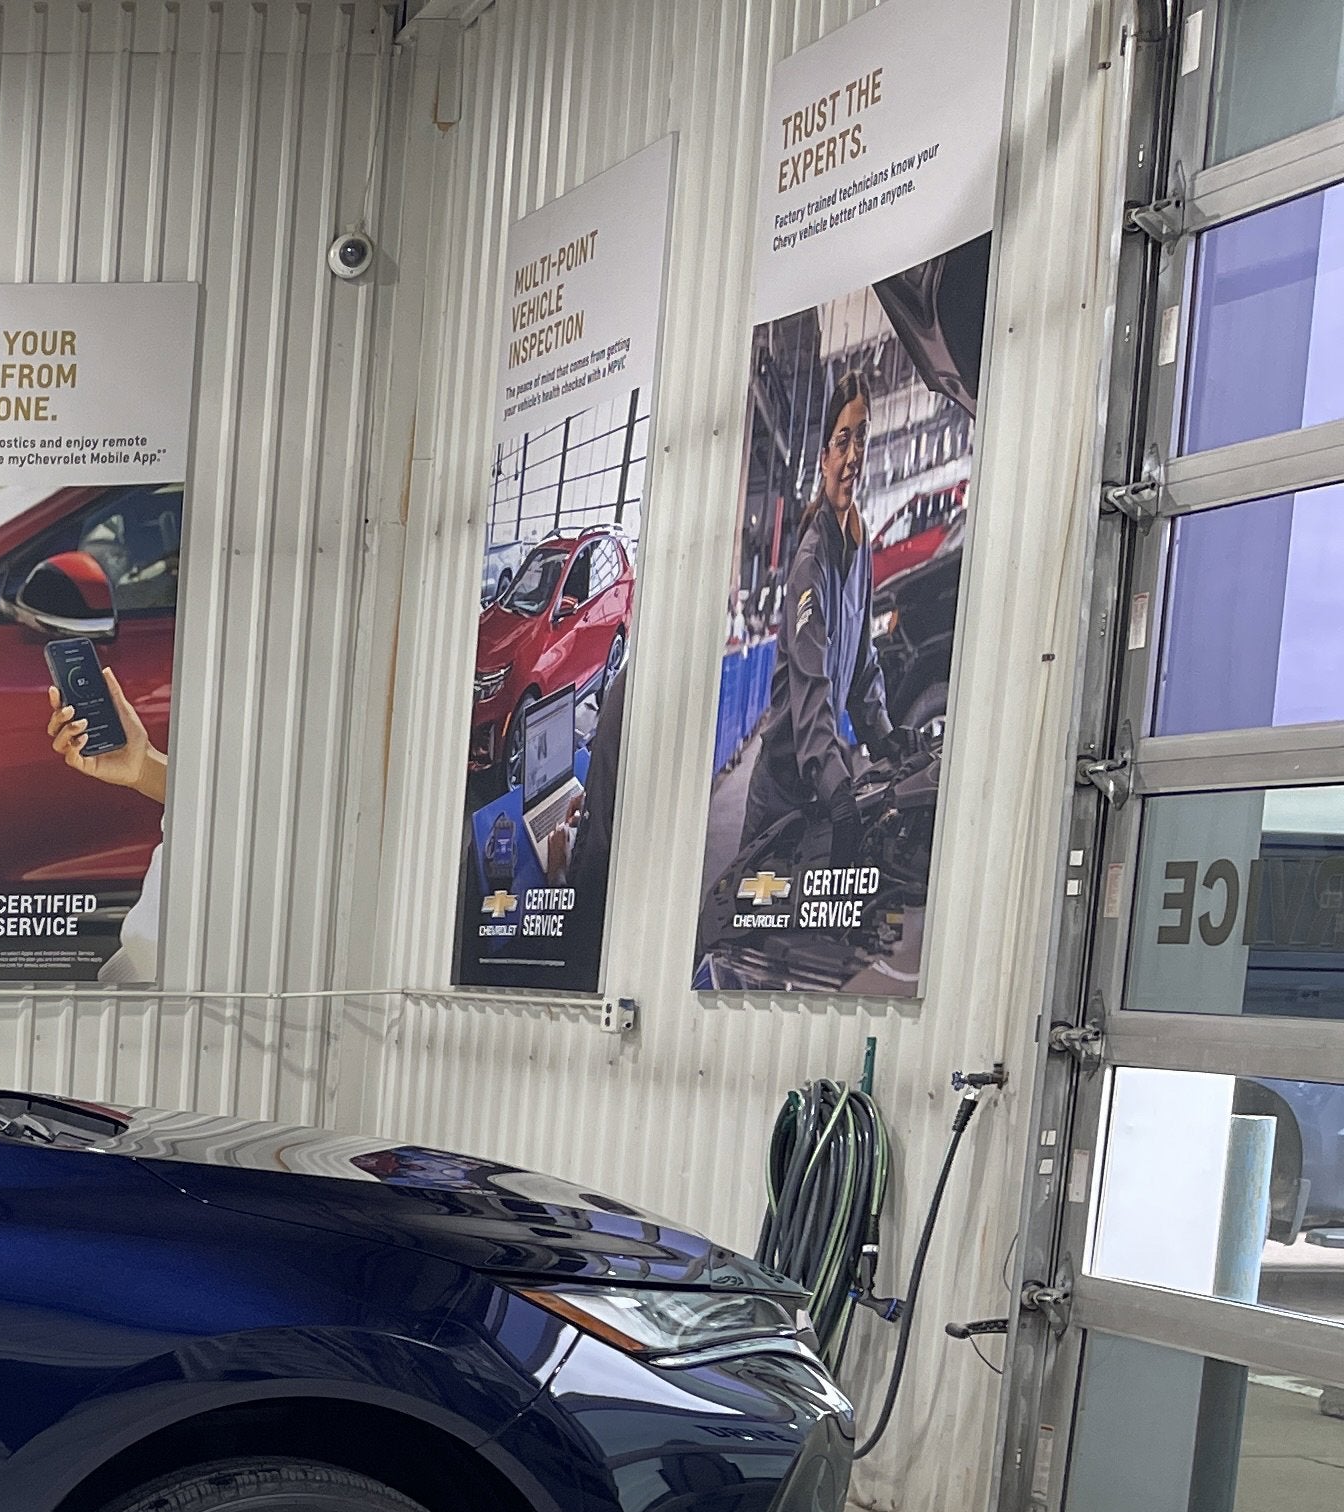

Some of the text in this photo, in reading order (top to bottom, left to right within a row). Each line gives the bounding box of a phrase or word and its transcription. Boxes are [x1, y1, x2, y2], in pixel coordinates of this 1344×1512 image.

[782, 67, 883, 150] TRUST THE
[778, 123, 867, 194] EXPERTS.
[774, 143, 940, 230] Factory trained technicians know your
[773, 180, 916, 252] Chevy vehicle better than anyone.
[513, 229, 598, 298] MULTI-POINT
[512, 283, 564, 333] VEHICLE
[3, 330, 77, 356] YOUR
[508, 310, 585, 370] INSPECTION
[1, 363, 77, 389] FROM
[40, 436, 62, 448] and
[66, 436, 99, 450] enjoy
[102, 435, 147, 447] remote
[8, 453, 87, 467] myChevrolet
[90, 452, 130, 464] Mobile
[803, 867, 880, 896] CERTIFIED
[525, 888, 575, 911] CERTIFIED
[522, 915, 564, 937] SERVICE
[733, 914, 791, 928] CHEVROLET
[799, 901, 863, 928] SERVICE
